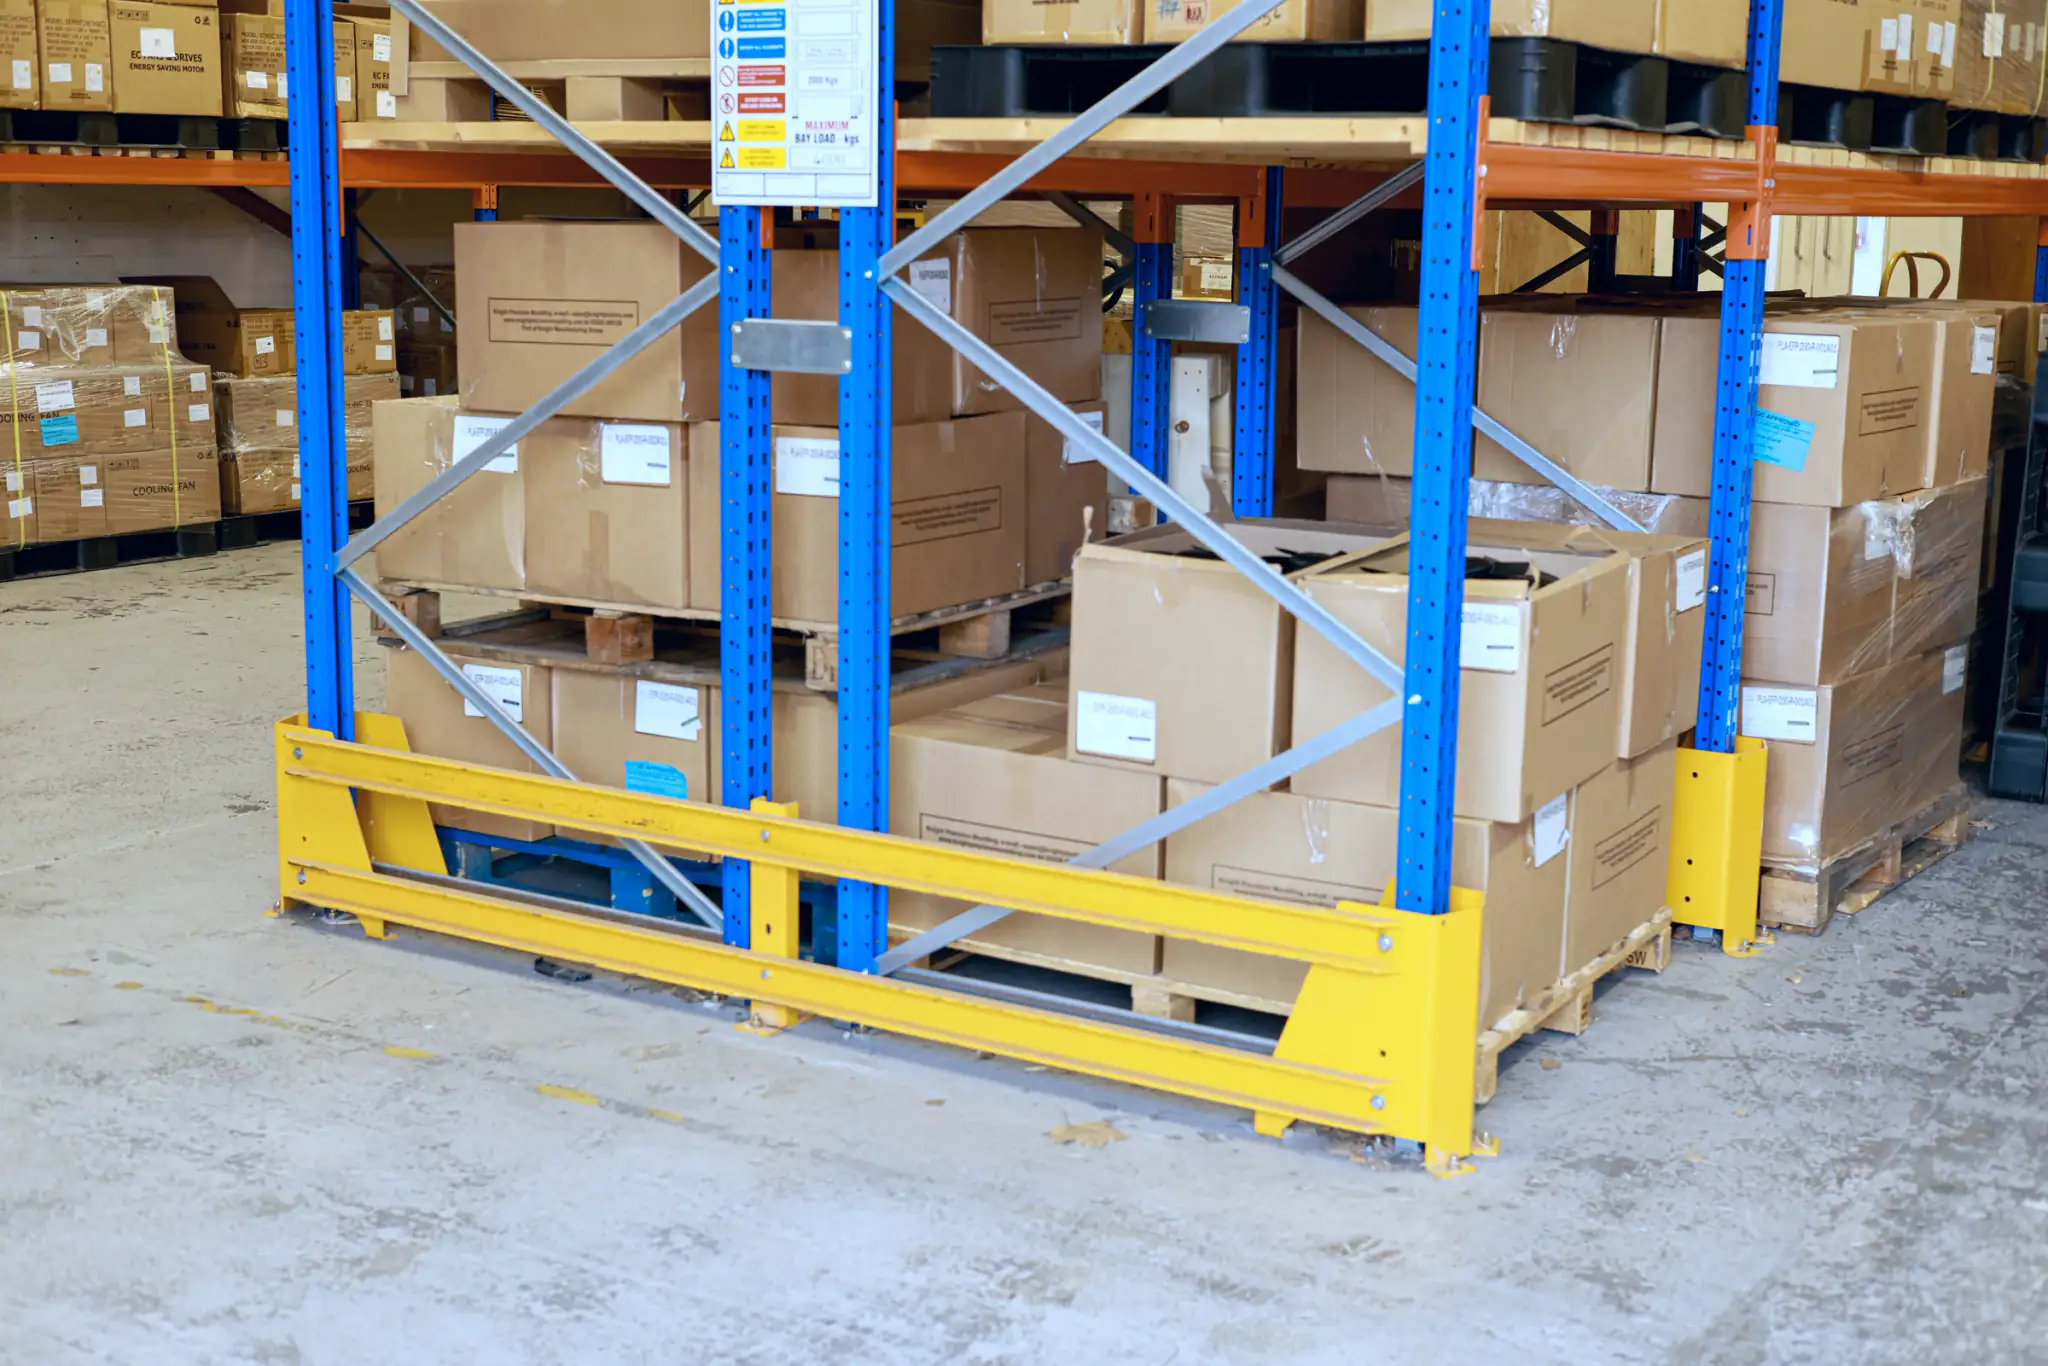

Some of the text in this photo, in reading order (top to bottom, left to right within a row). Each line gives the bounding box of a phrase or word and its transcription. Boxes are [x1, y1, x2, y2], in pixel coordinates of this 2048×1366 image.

[174, 53, 203, 62] DRIVES
[129, 63, 155, 71] ENERGY
[156, 64, 181, 72] SAVING
[372, 71, 381, 80] EC
[805, 121, 849, 130] MAXIMUM
[795, 133, 811, 144] BAY
[814, 134, 835, 144] LOAD
[844, 133, 860, 147] kgs
[132, 480, 196, 497] COOLING FAN
